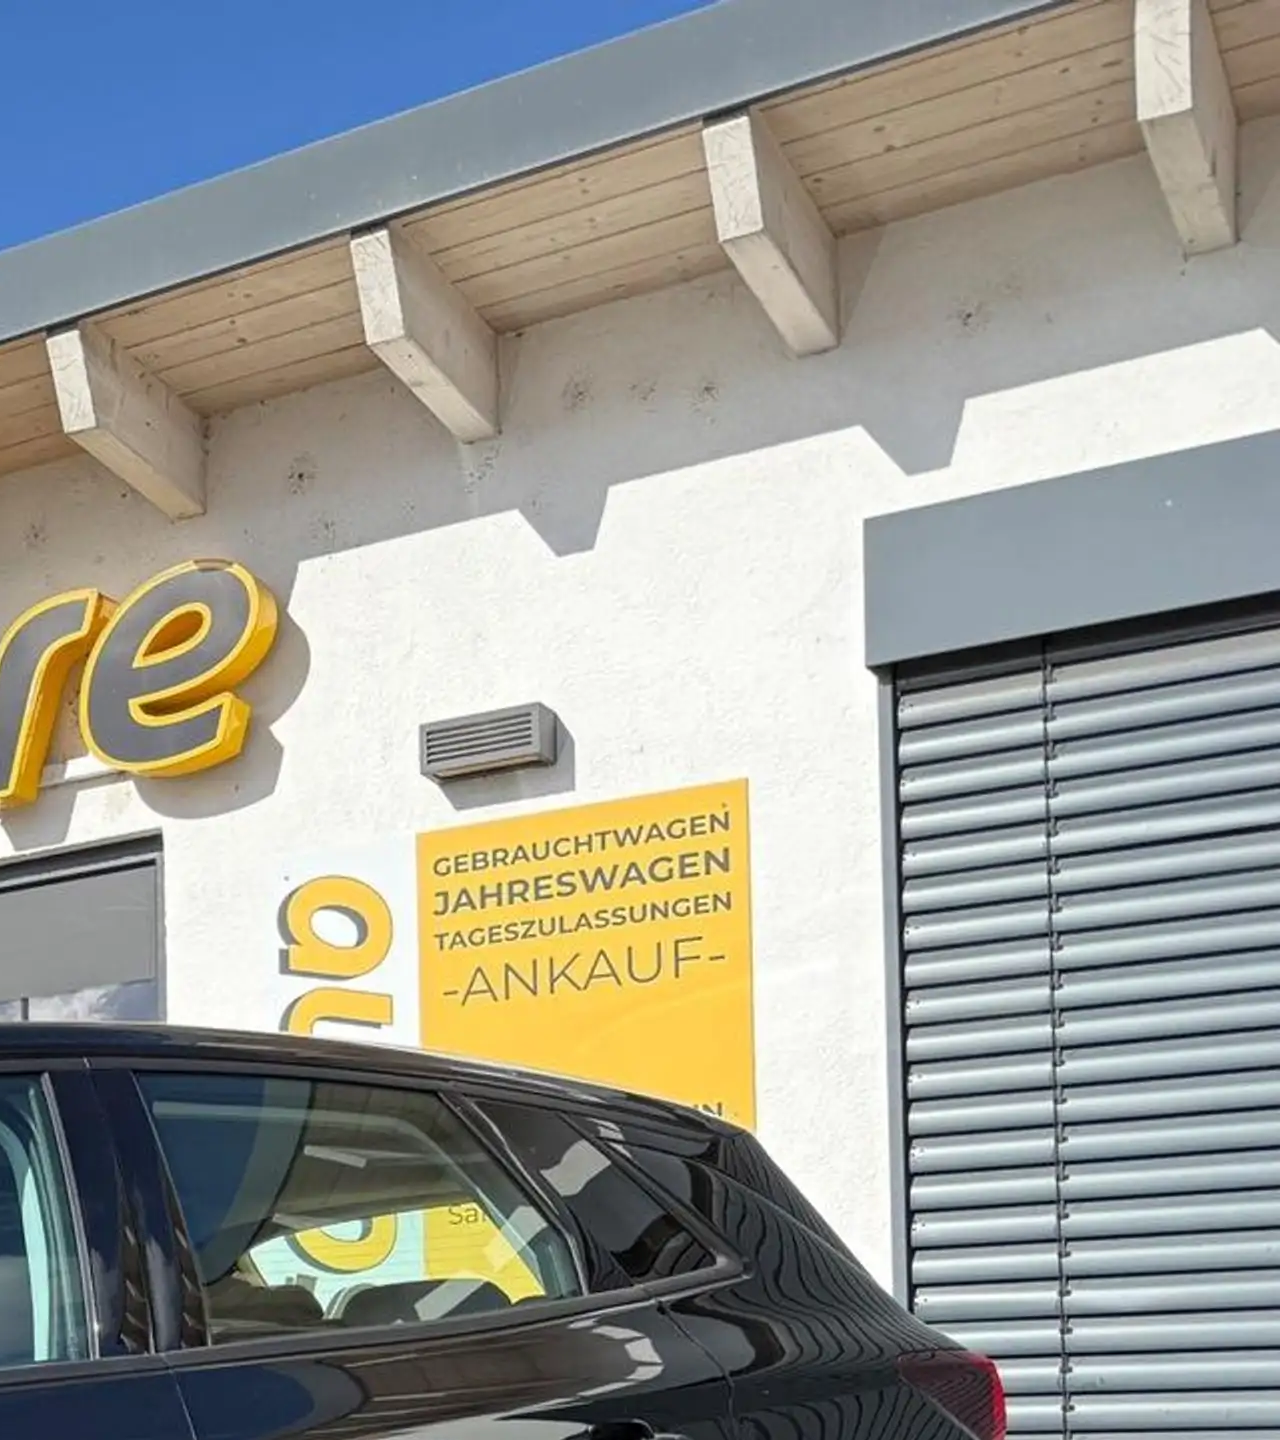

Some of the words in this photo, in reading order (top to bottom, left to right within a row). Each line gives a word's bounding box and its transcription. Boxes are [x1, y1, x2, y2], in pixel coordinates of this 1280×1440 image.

[433, 810, 731, 877] GEBRAUCHTWAGEN
[433, 847, 731, 916] JAHRESWAGEN
[434, 891, 732, 951] TAGESZULASSUNGEN
[443, 935, 726, 1006] -ANKAUF-
